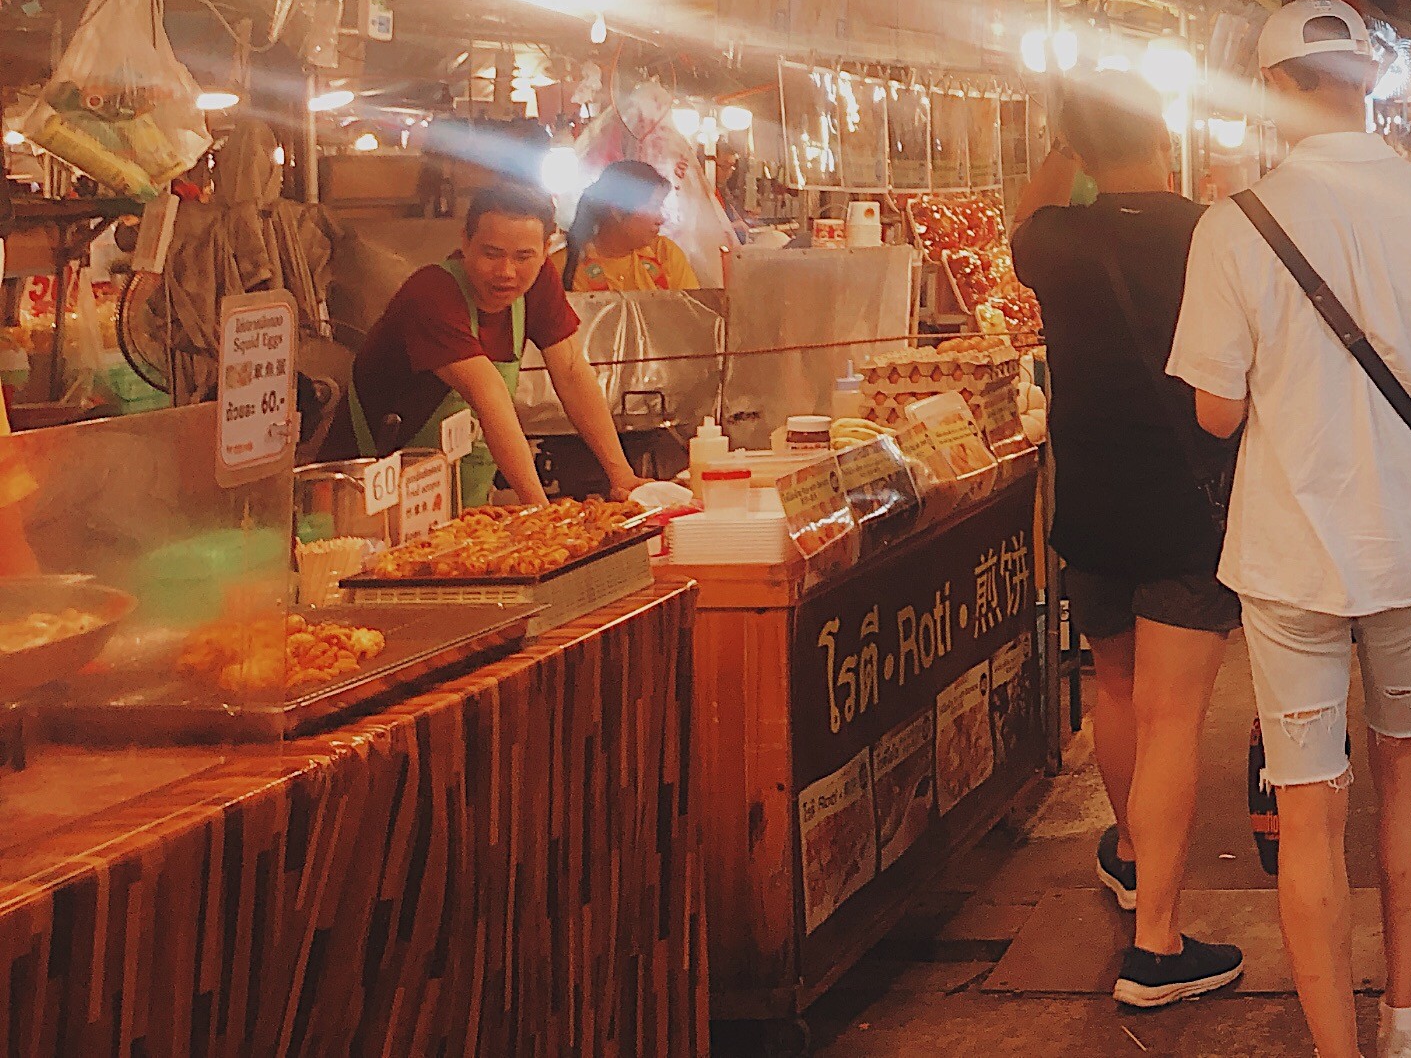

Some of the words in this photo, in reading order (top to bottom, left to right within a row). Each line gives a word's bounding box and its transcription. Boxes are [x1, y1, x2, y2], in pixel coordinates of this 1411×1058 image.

[372, 465, 396, 501] 60
[817, 603, 880, 734] โรตี
[897, 580, 952, 686] Roti
[973, 530, 1029, 639] 煎饼
